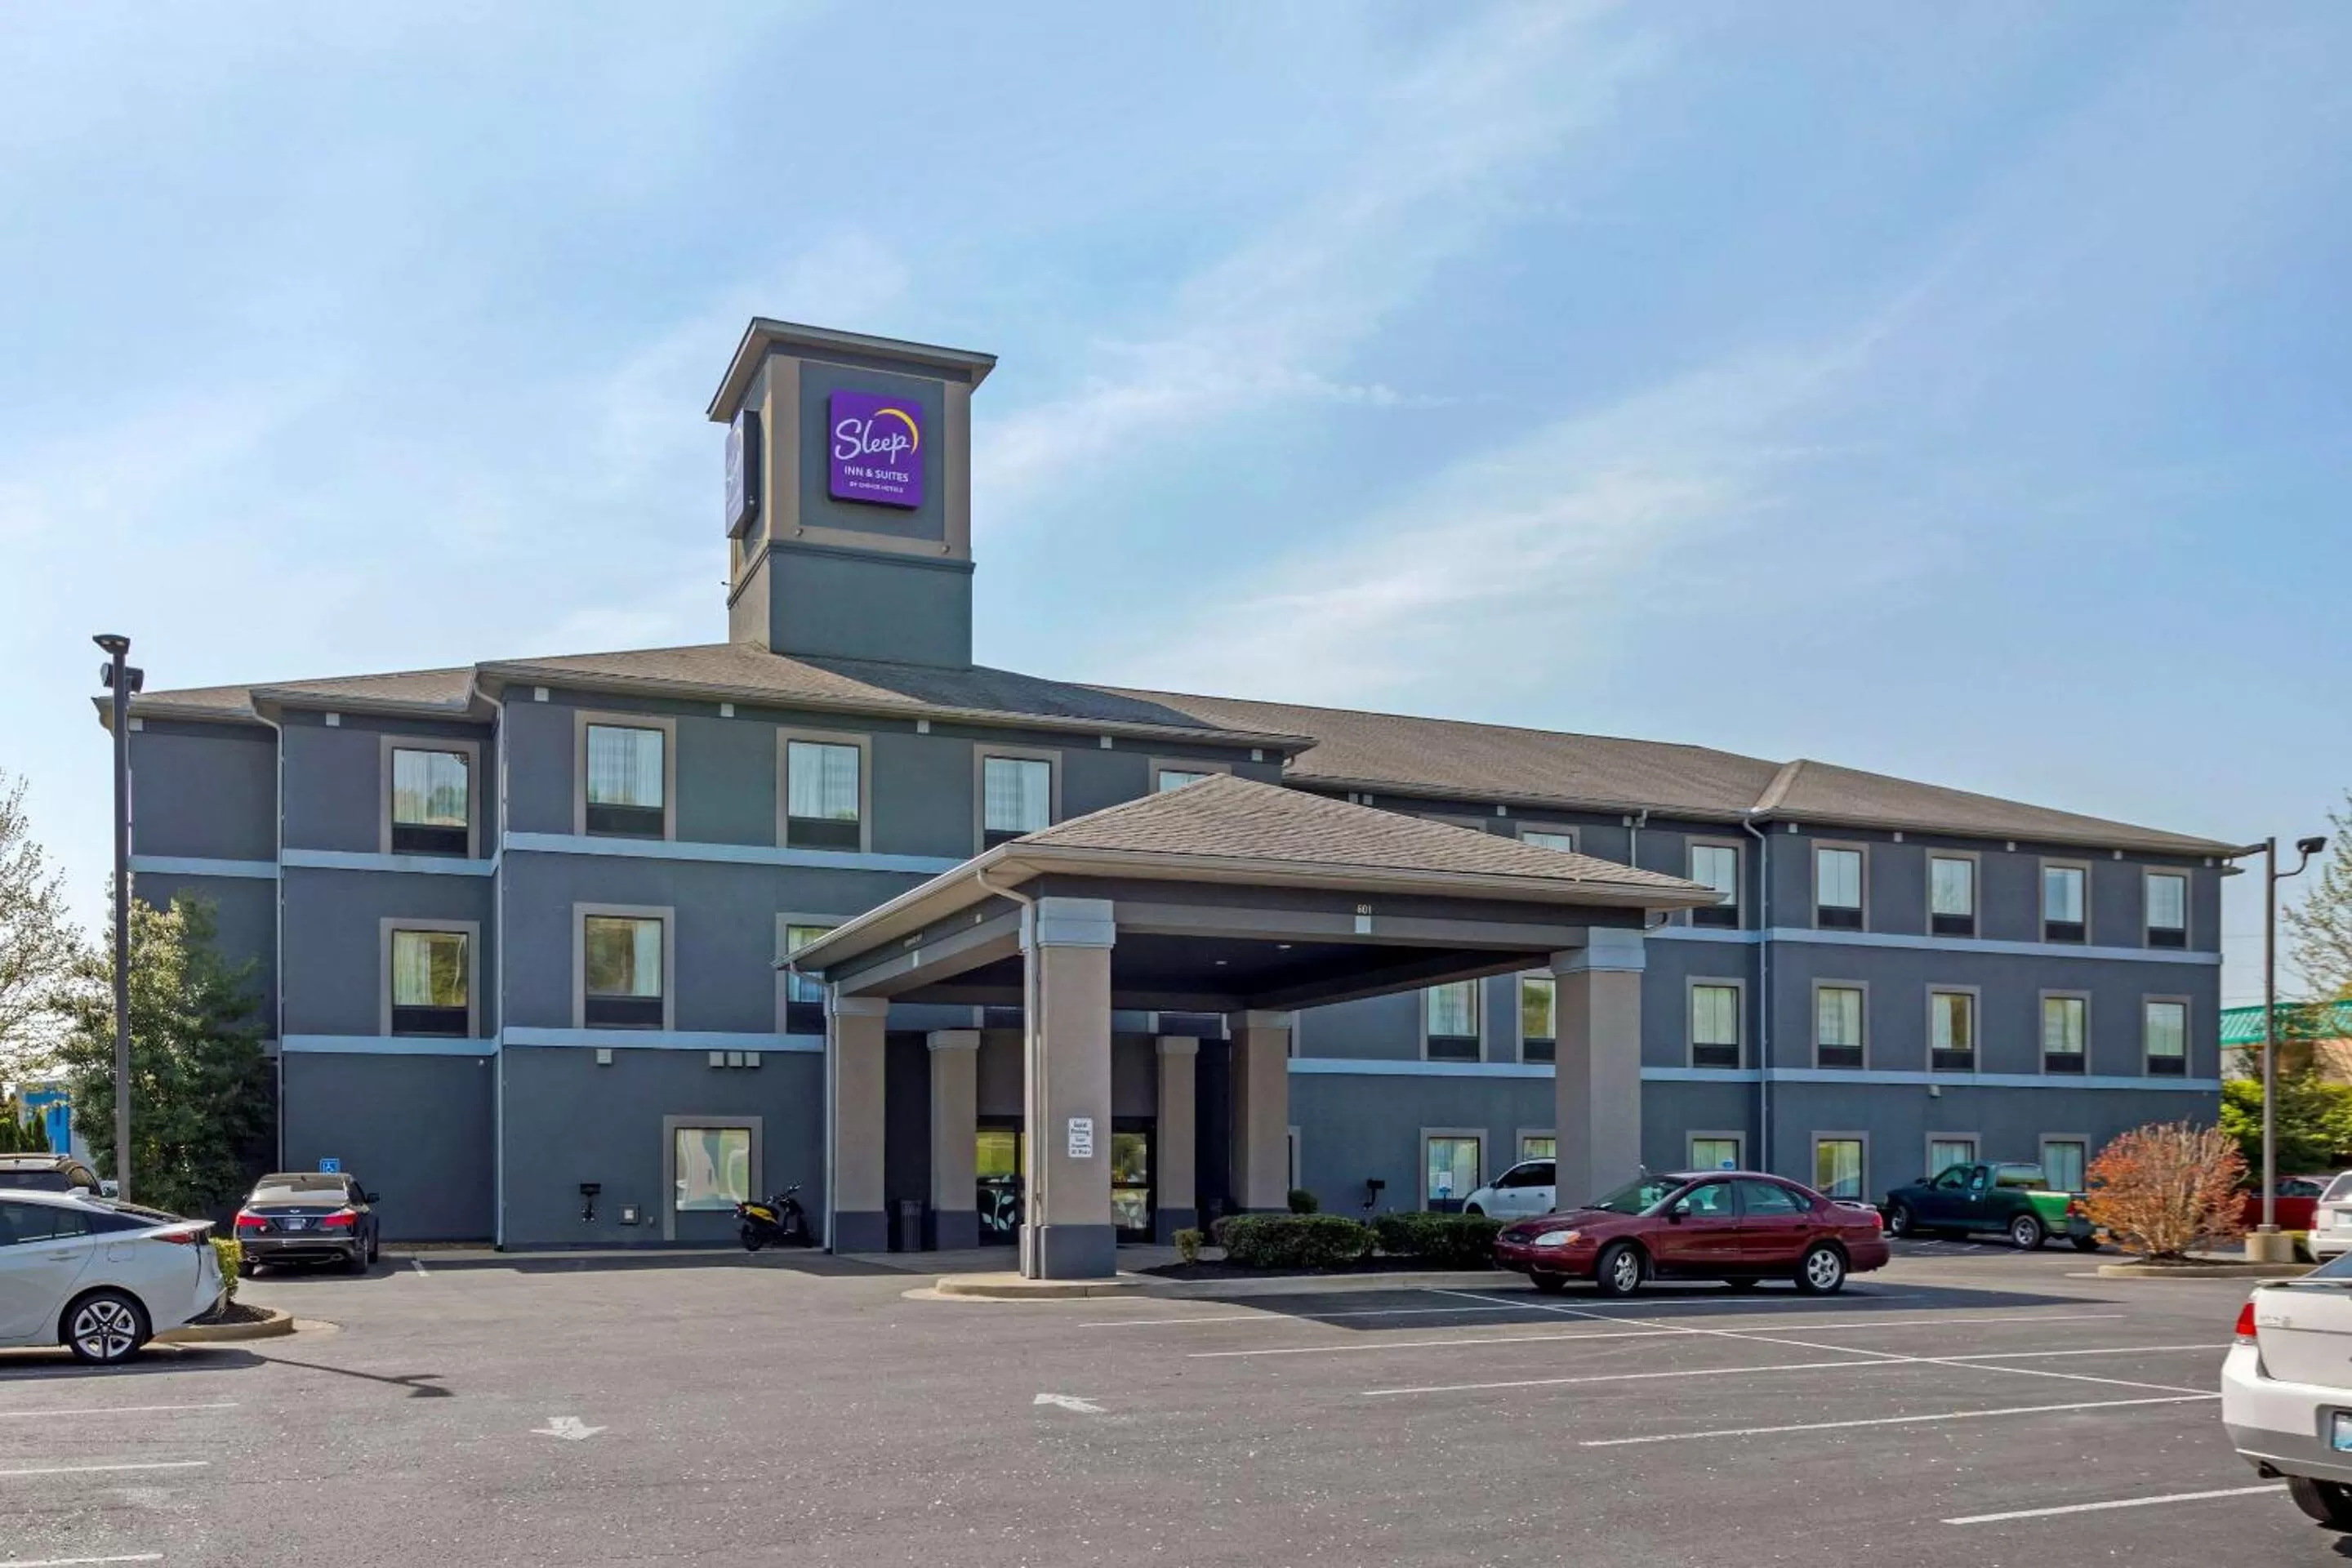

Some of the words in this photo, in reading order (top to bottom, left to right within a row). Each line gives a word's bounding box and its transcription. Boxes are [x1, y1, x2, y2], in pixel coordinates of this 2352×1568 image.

[835, 418, 910, 465] Sleep
[844, 465, 863, 477] INN
[866, 468, 874, 478] &
[875, 470, 909, 483] SUITES
